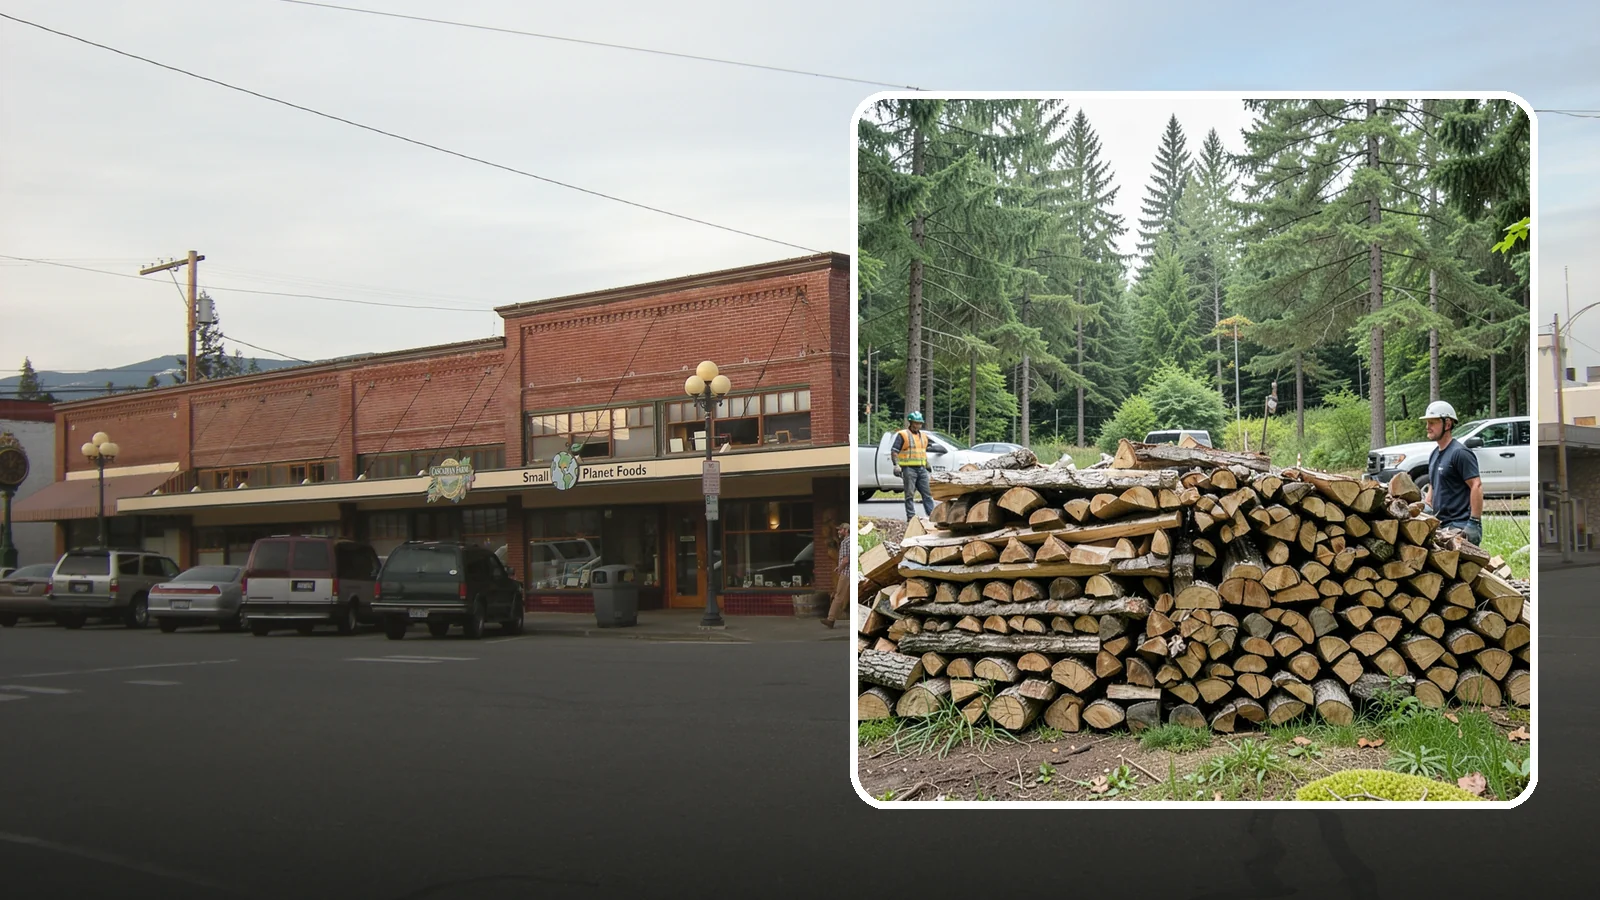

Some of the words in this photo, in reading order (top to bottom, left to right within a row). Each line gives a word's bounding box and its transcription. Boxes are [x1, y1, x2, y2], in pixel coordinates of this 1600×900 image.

[523, 471, 549, 483] Small
[583, 467, 614, 479] Planet
[617, 464, 647, 477] Foods
